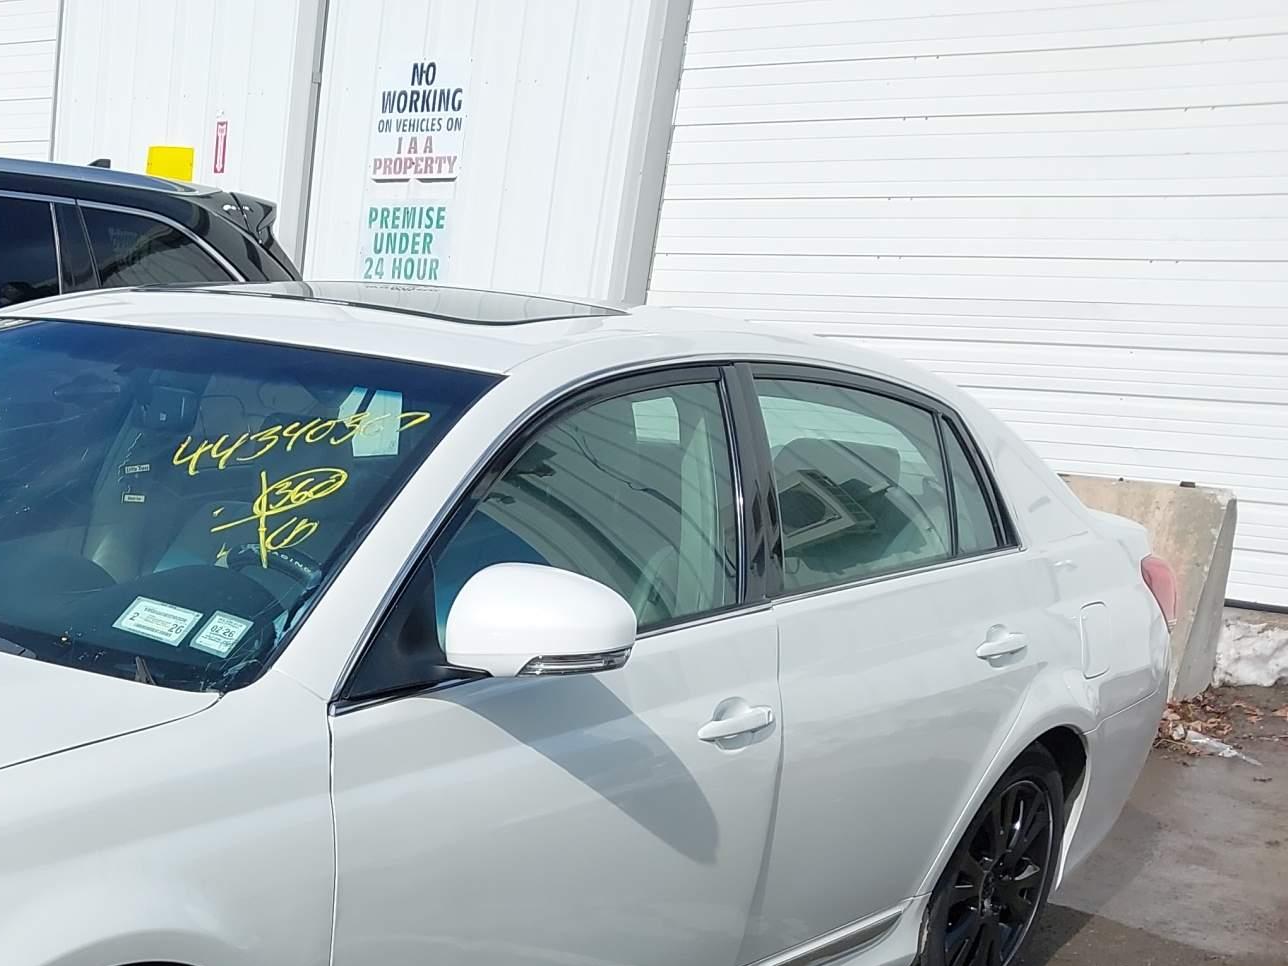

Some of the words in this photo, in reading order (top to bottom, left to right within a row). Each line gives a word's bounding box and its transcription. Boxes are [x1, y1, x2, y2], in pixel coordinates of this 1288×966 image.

[410, 61, 437, 87] NO
[381, 87, 464, 114] WORKING
[377, 118, 393, 134] ON
[395, 117, 443, 133] VEHICLES
[446, 117, 463, 132] ON
[372, 155, 458, 176] PROPERTY
[368, 206, 447, 230] PREMISE
[372, 231, 434, 255] UNDER
[363, 257, 385, 280] 24
[391, 256, 440, 281] HOUR
[168, 623, 185, 635] 26
